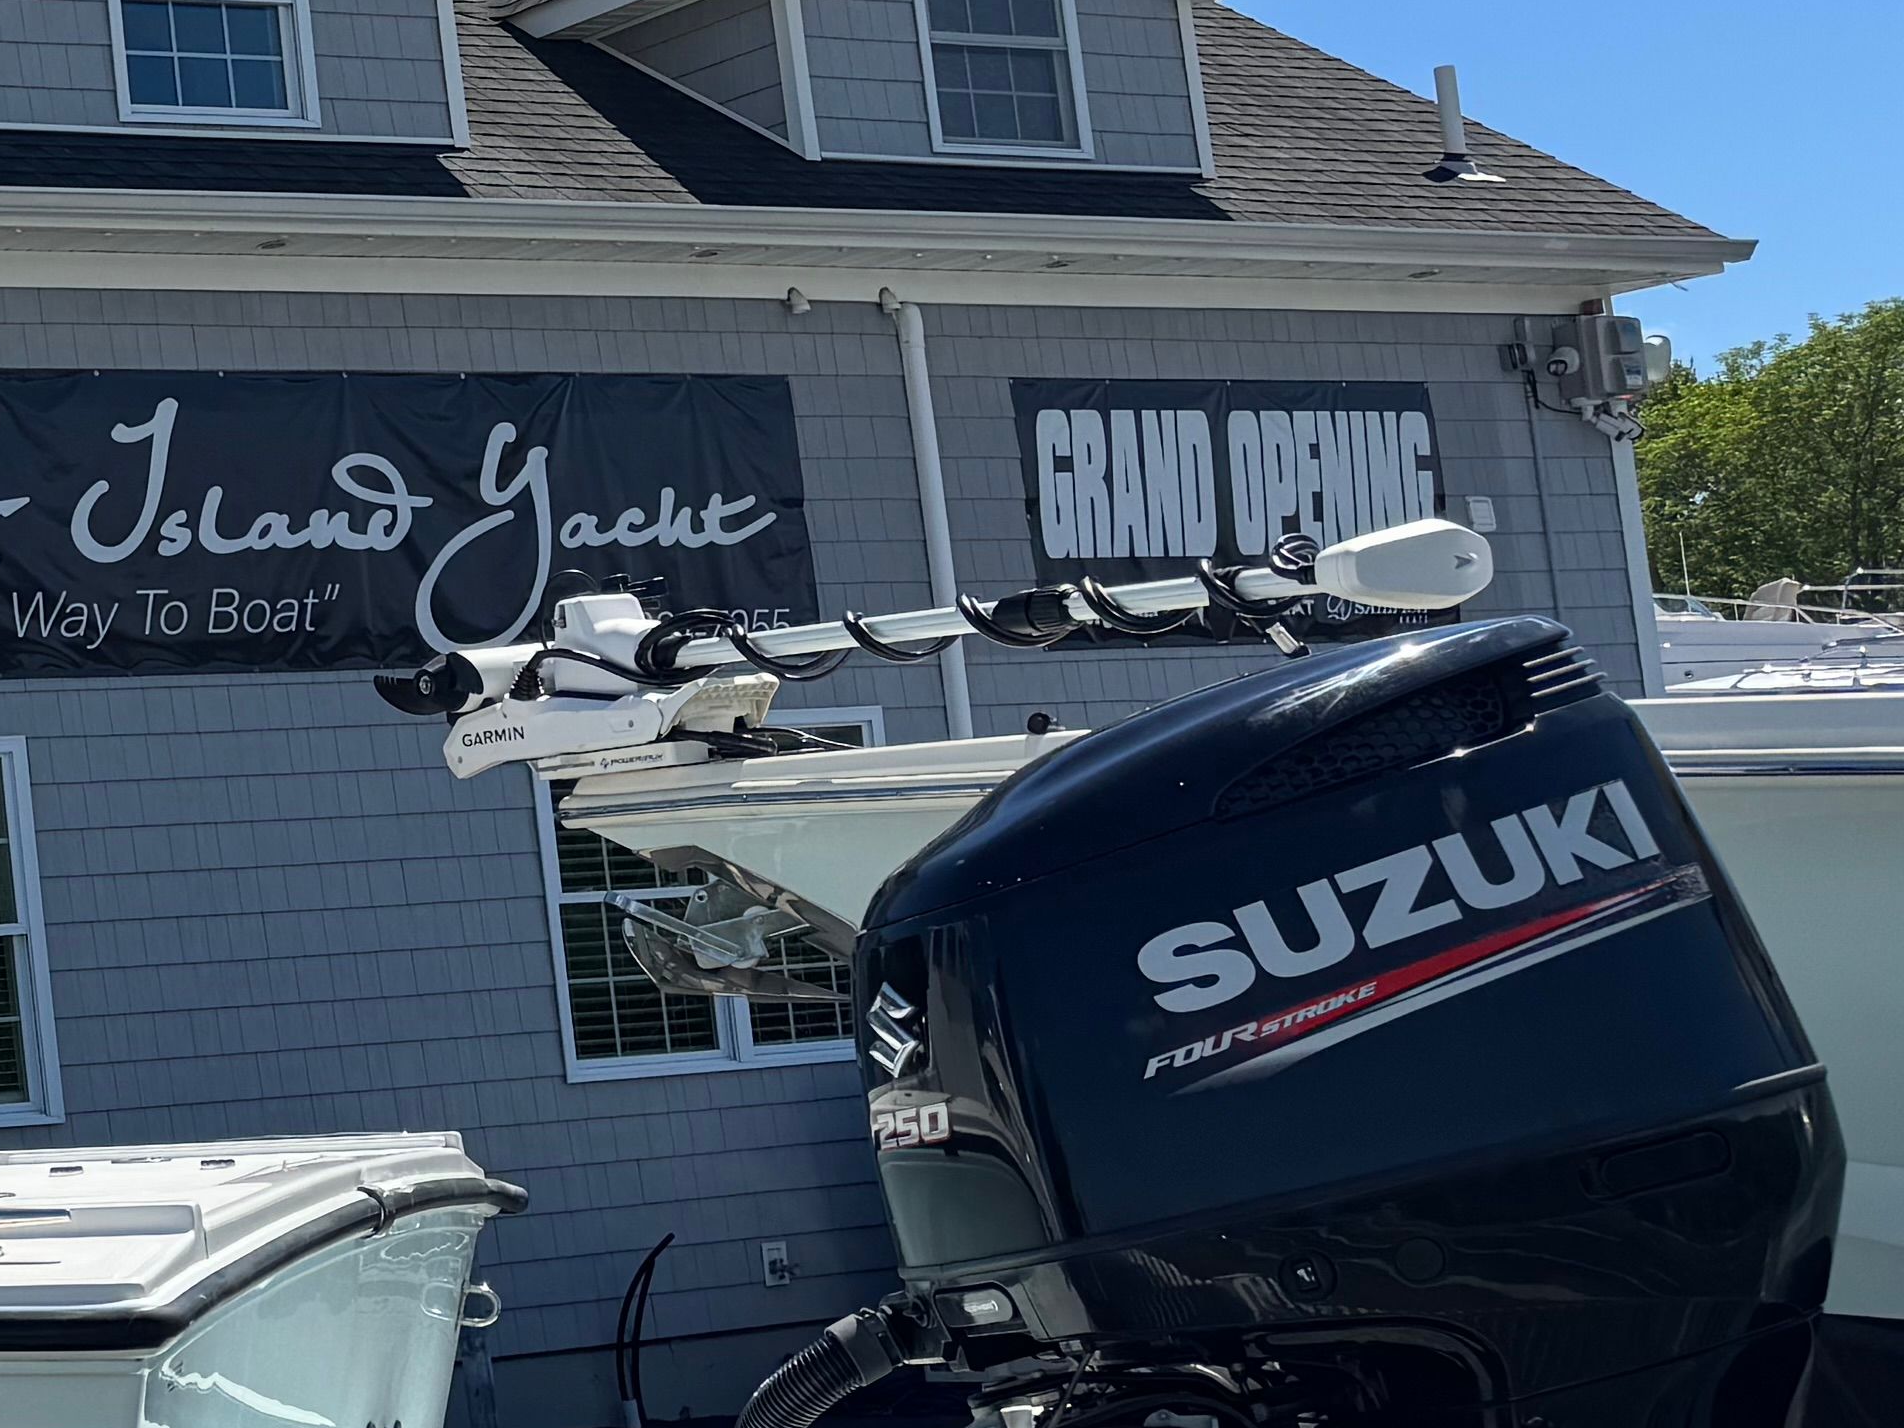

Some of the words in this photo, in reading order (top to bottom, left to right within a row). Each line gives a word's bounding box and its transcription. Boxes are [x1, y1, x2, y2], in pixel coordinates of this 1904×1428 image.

[71, 397, 433, 563] Island
[415, 422, 776, 654] Yacht
[1036, 409, 1218, 559] GRAND
[1227, 410, 1435, 556] OPENING
[12, 590, 119, 649] Way
[136, 589, 189, 636] To
[461, 725, 526, 748] GARMIN
[1137, 778, 1662, 1013] SUZUKI
[876, 1102, 952, 1151] 250
